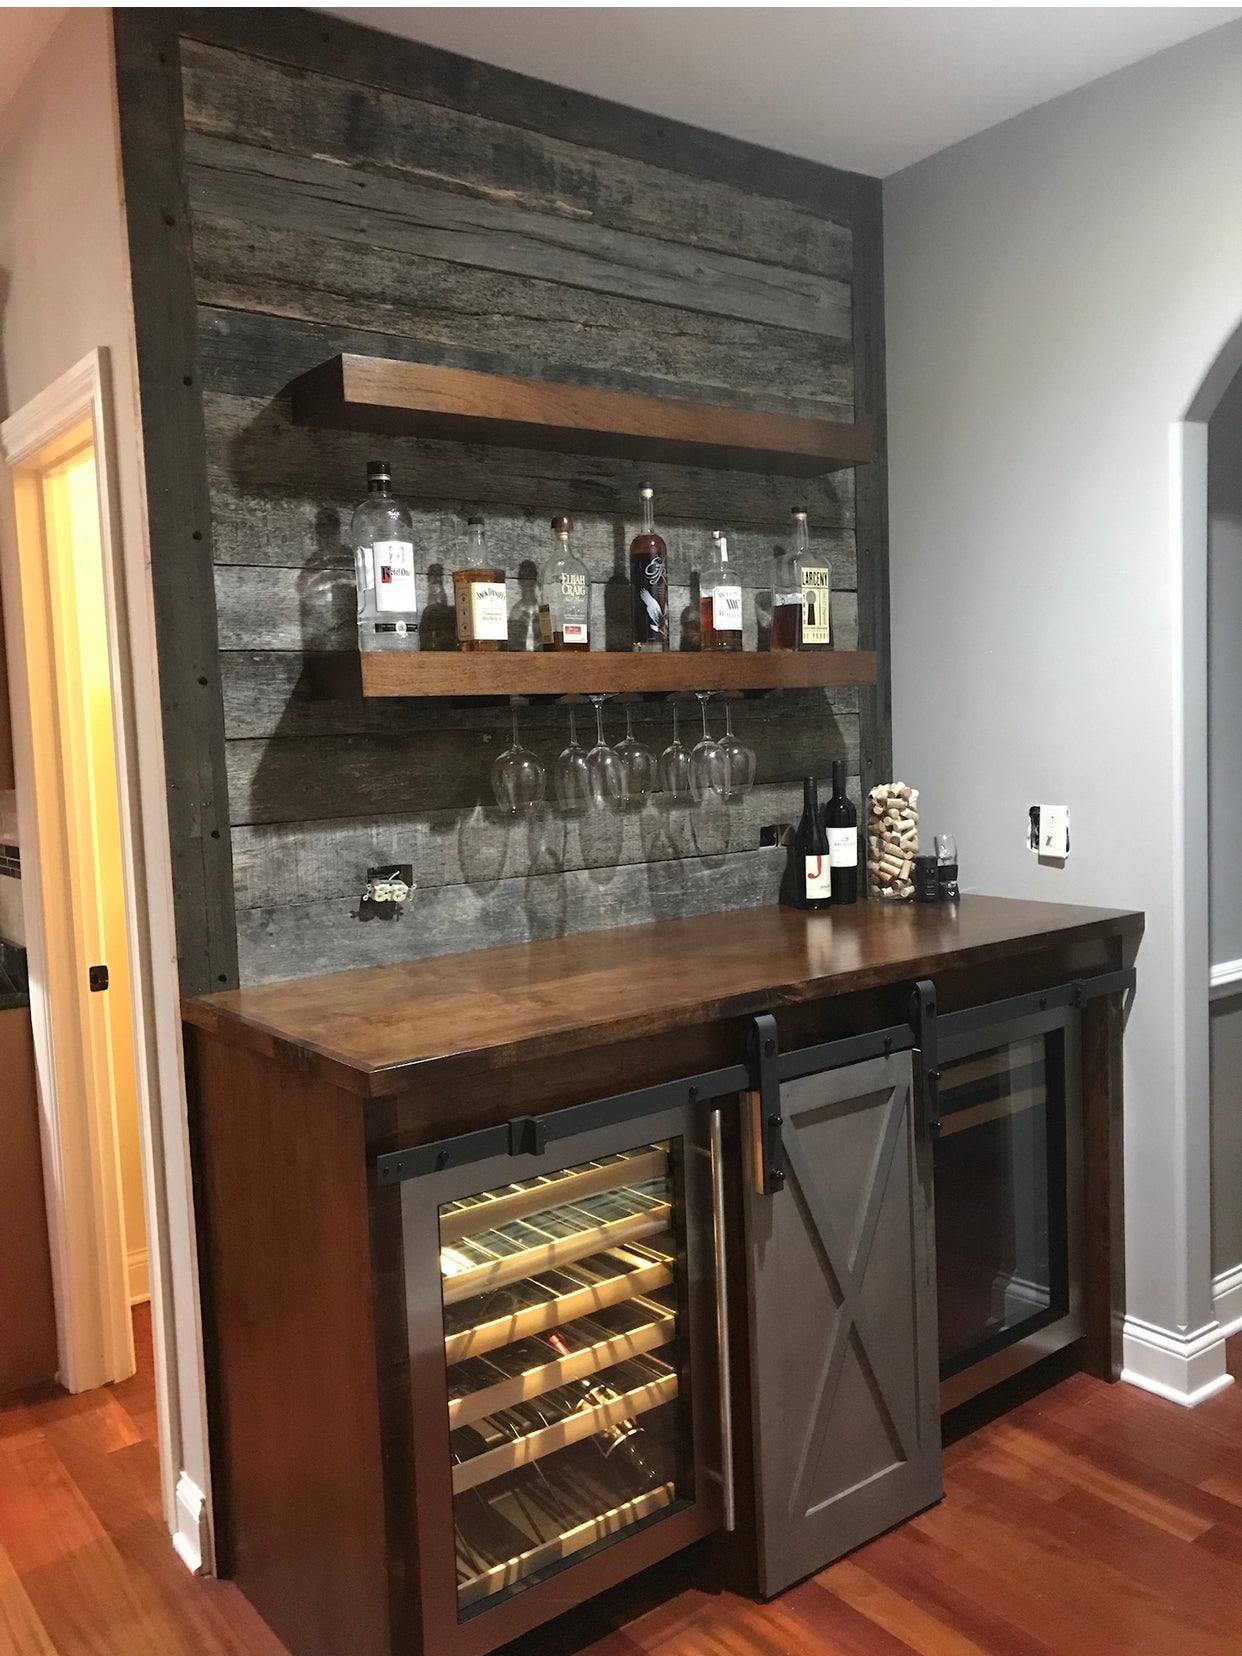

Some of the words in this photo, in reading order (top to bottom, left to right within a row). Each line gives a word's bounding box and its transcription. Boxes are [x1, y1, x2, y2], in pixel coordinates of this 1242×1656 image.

[561, 573, 586, 585] ELIJAH
[561, 584, 586, 596] CRAIG
[807, 854, 823, 879] J
